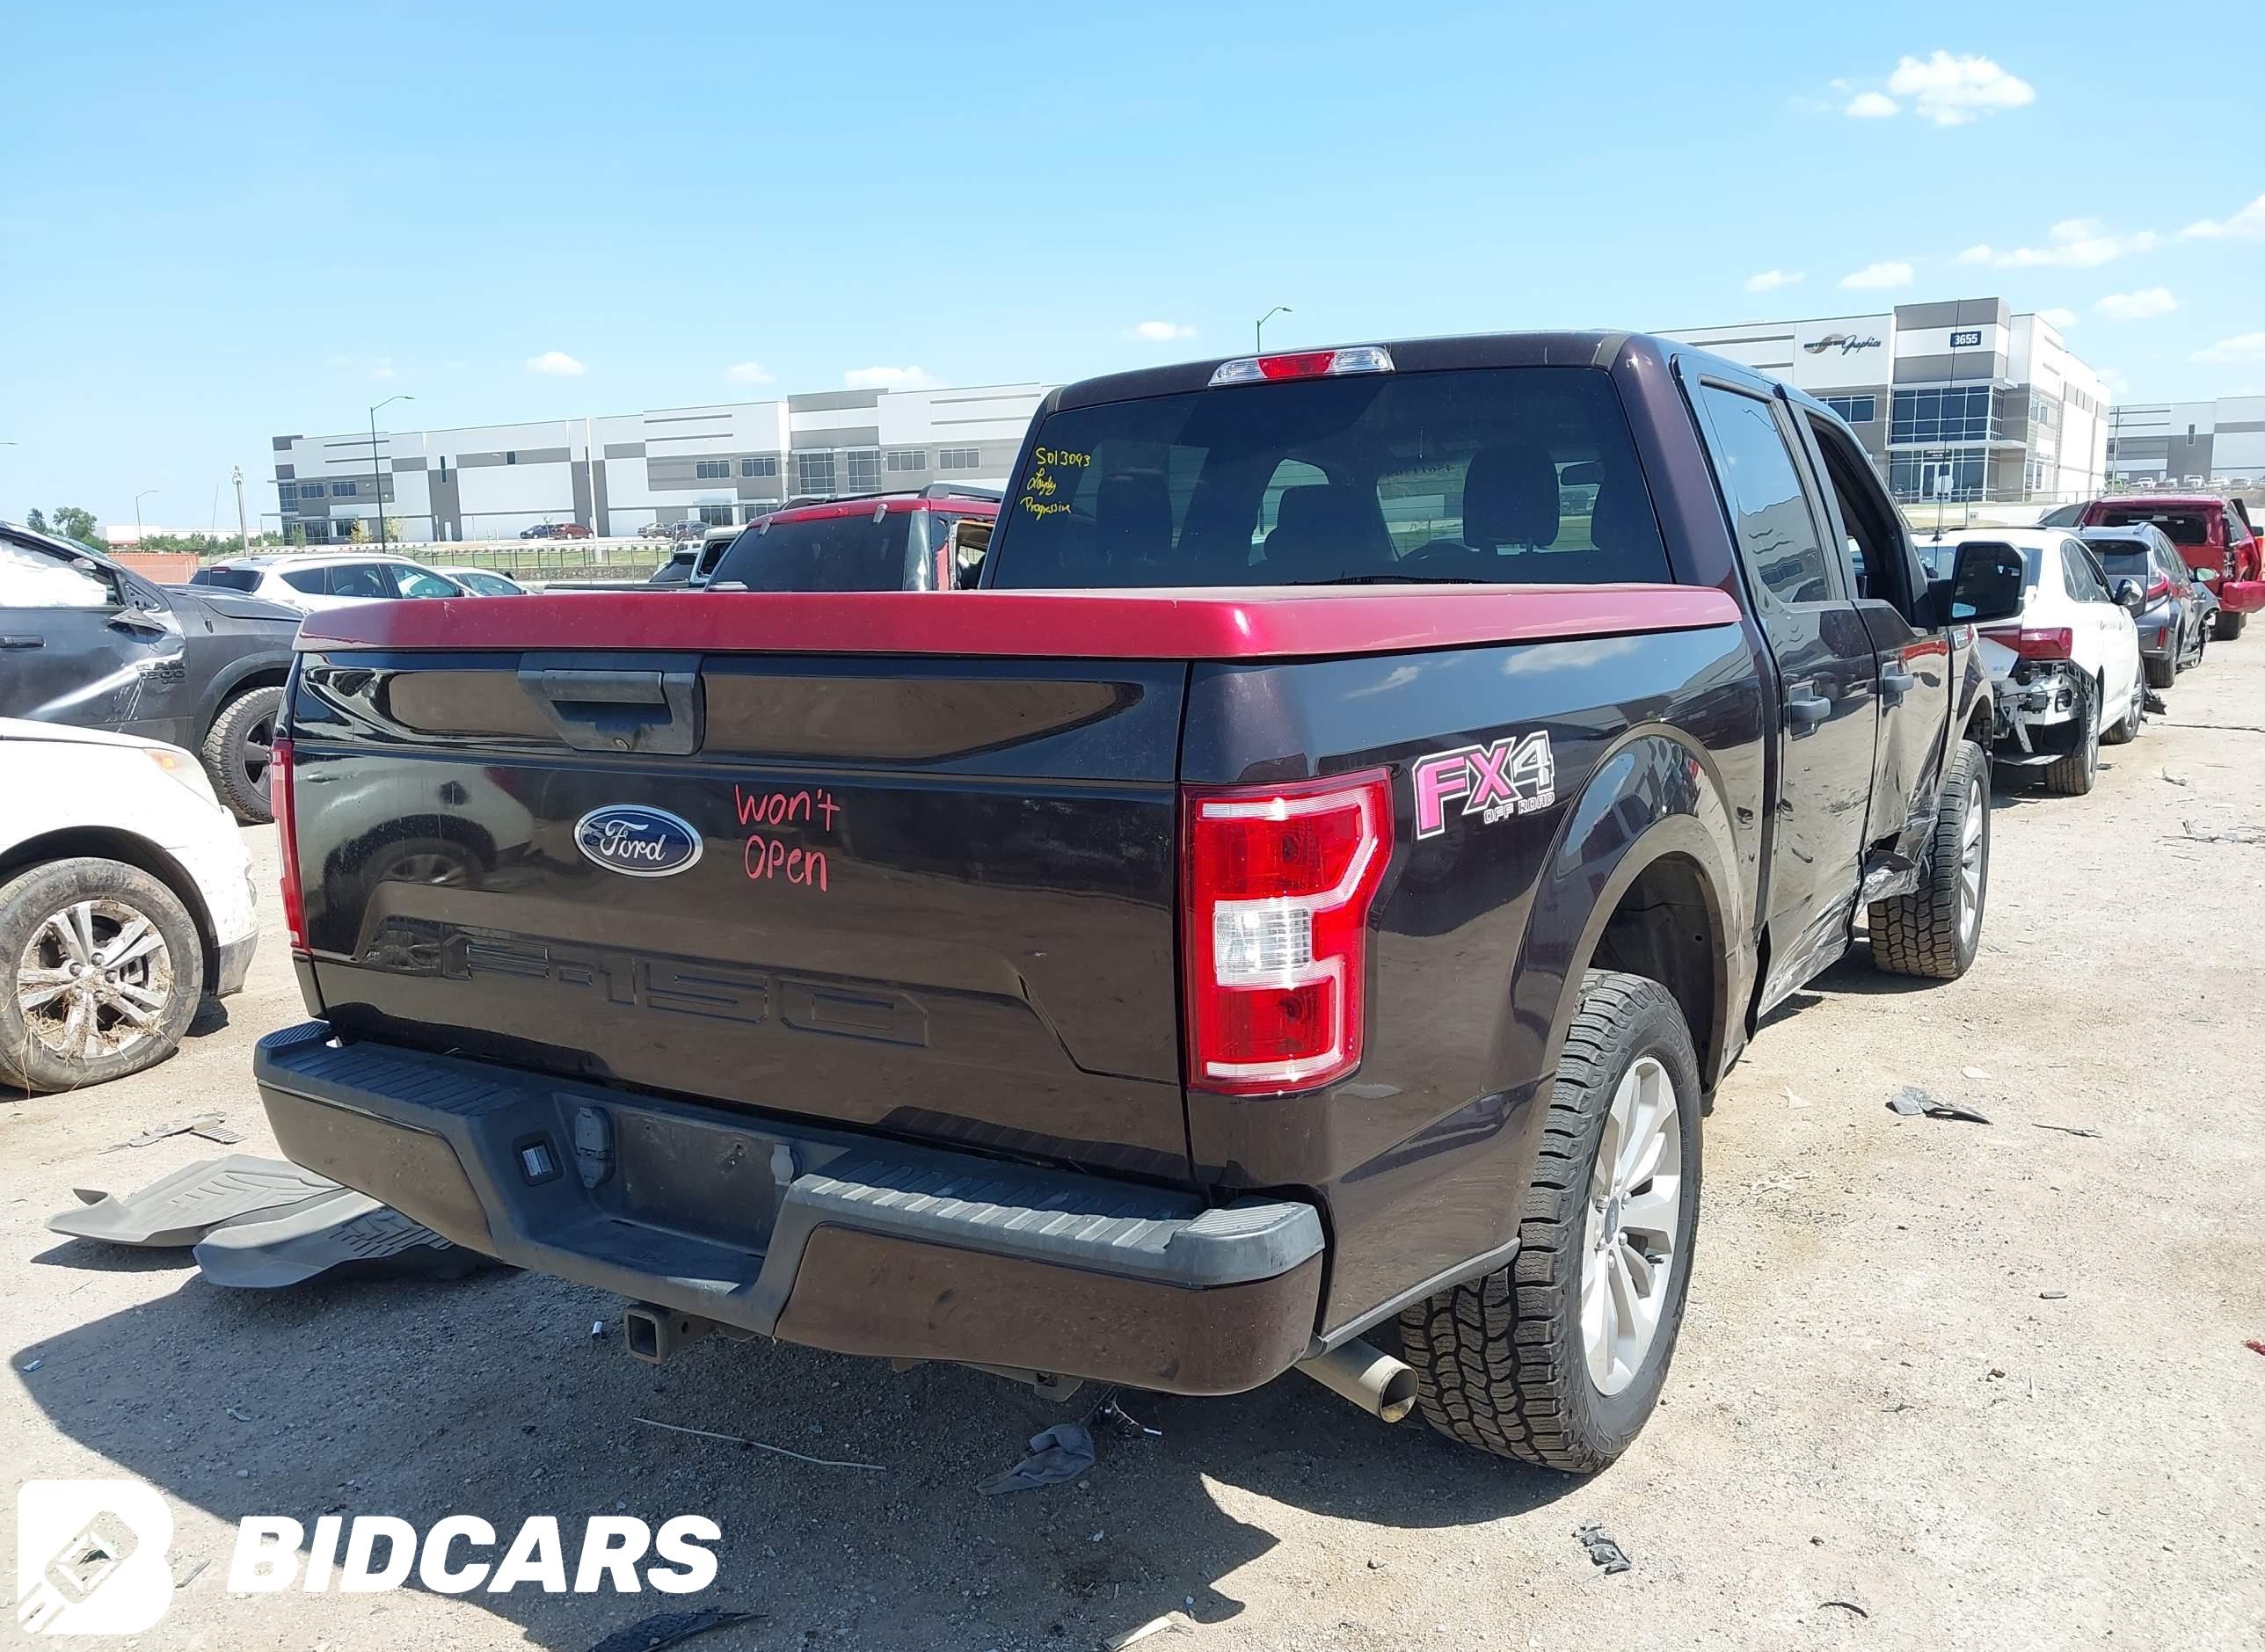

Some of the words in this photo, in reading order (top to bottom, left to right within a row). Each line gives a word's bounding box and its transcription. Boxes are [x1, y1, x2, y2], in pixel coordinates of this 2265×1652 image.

[1842, 334, 1882, 356] Graphics
[1955, 333, 1978, 346] 3655
[1412, 729, 1555, 841] FX4
[1483, 803, 1514, 825] OFF
[1518, 791, 1555, 815] ROAD
[599, 819, 667, 862] Ford
